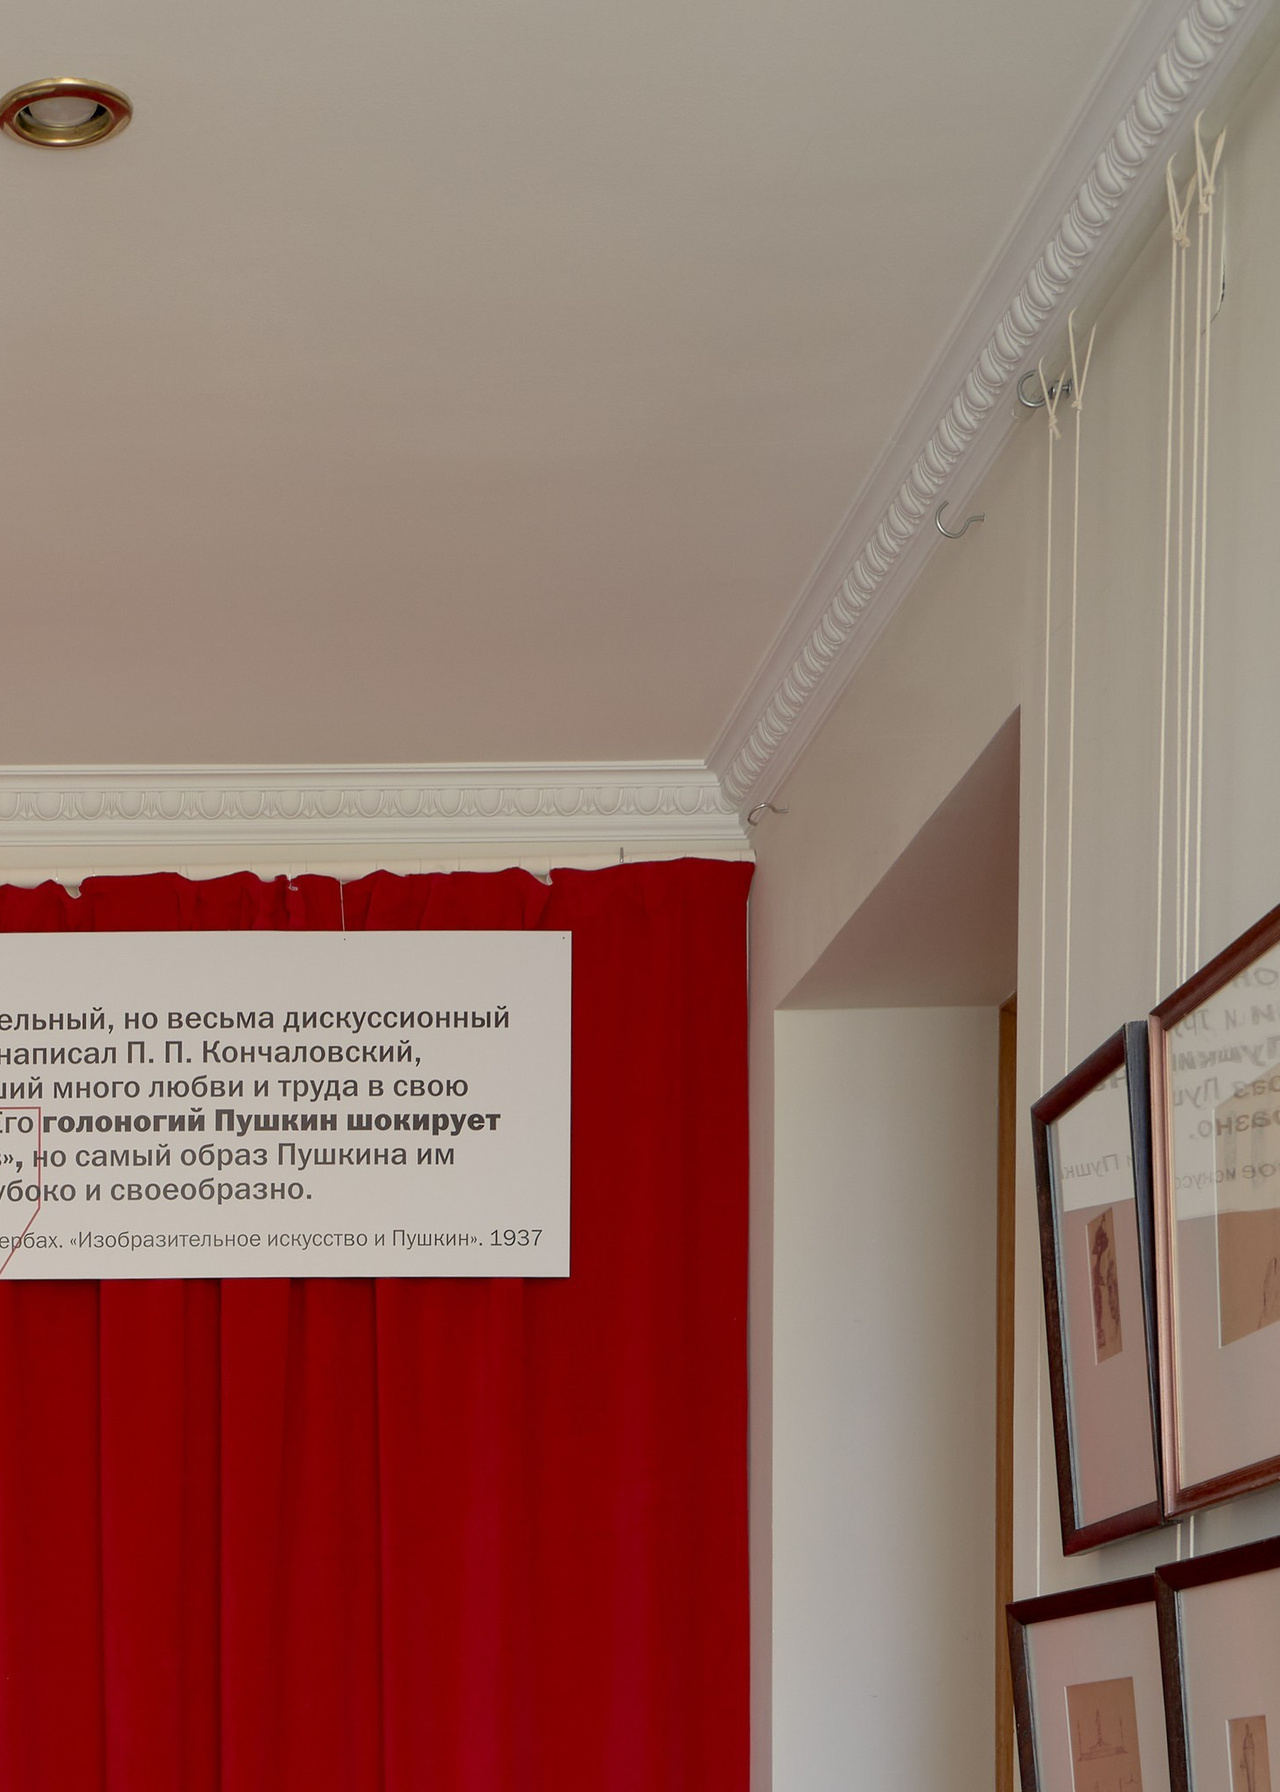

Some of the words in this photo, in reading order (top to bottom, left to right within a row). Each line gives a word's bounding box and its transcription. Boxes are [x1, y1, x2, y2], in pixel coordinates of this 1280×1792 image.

[124, 1011, 159, 1030] но
[167, 1011, 274, 1030] весьма
[282, 1005, 509, 1034] дискуссионный
[127, 1040, 154, 1064] П.
[165, 1040, 192, 1064] П.
[202, 1039, 421, 1068] Кончаловский,
[53, 1080, 141, 1099] много
[148, 1074, 244, 1098] любви
[254, 1079, 269, 1097] и
[277, 1079, 359, 1103] труда
[368, 1079, 384, 1097] в
[393, 1079, 469, 1097] свою
[41, 1107, 206, 1134] голоногий
[215, 1108, 338, 1137] Пушкин
[346, 1113, 502, 1137] шокирует
[33, 1147, 67, 1168] но
[75, 1143, 171, 1168] самый
[180, 1142, 268, 1171] образ
[278, 1142, 407, 1171] Пушкина
[417, 1147, 455, 1166] им
[85, 1183, 101, 1202] и
[110, 1177, 312, 1206] своеобразно.
[69, 1230, 261, 1252] «Изобразительное
[267, 1232, 368, 1251] искусство
[374, 1233, 385, 1247] и
[392, 1229, 483, 1251] Пушкин».
[490, 1228, 543, 1247] 1937
